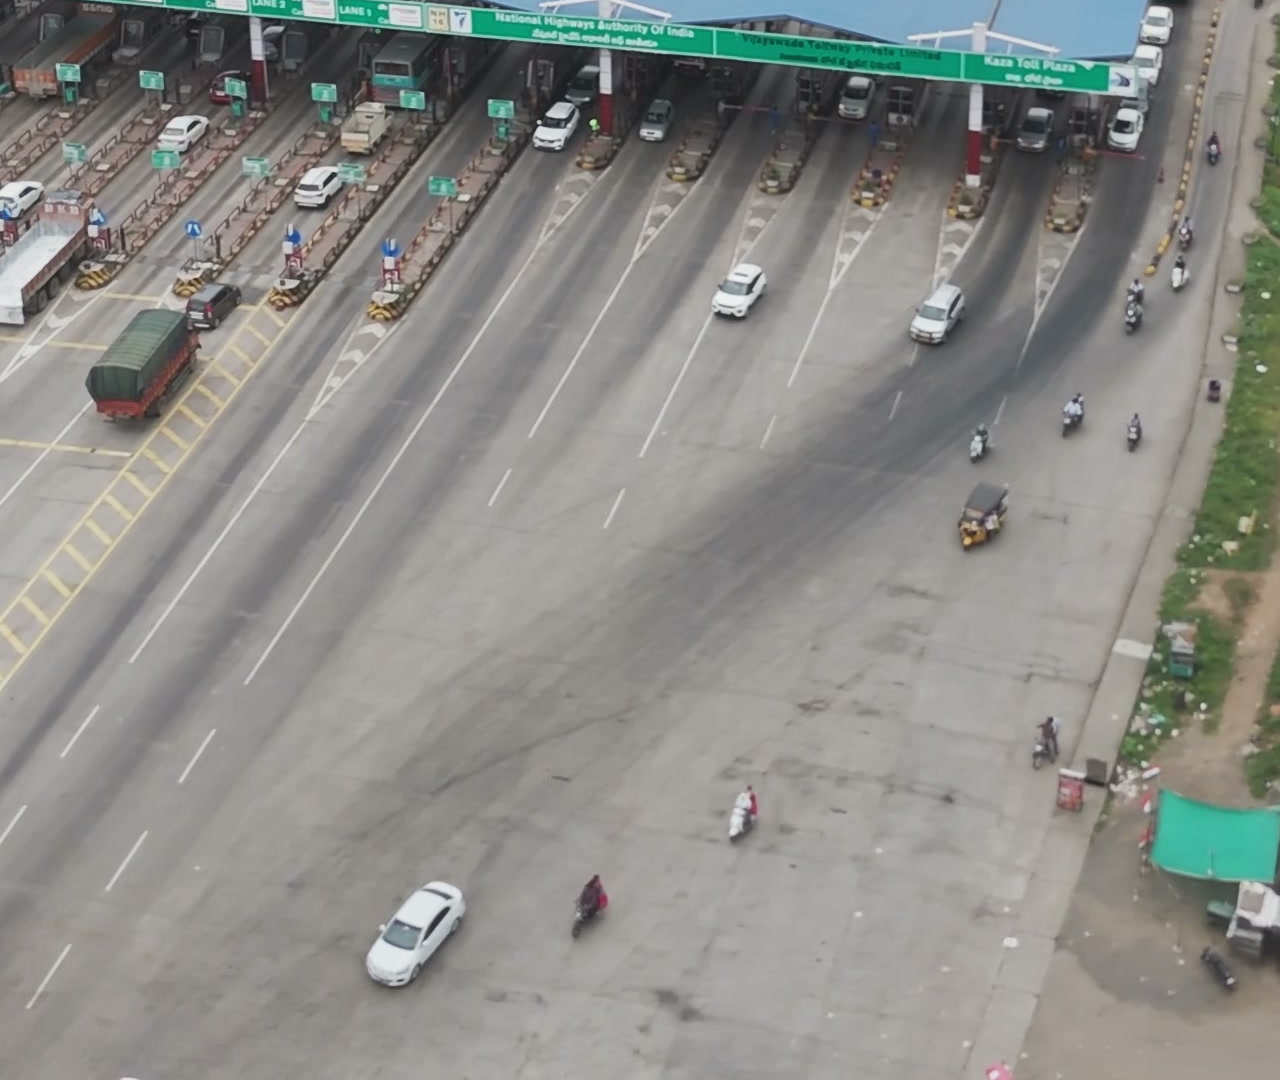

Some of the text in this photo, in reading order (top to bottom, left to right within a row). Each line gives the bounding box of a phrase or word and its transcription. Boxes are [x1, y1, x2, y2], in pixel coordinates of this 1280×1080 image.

[279, 0, 286, 8] 2
[339, 6, 365, 16] LANE
[430, 10, 446, 18] NH
[495, 12, 542, 25] National
[544, 16, 595, 30] Highways
[597, 20, 648, 35] Authority
[651, 24, 665, 34] Of
[668, 27, 695, 38] India
[742, 34, 804, 48] Vijayawada
[808, 40, 851, 54] Tollway
[855, 44, 895, 57] Private
[899, 49, 941, 61] Limited
[984, 56, 1076, 73] Kaza Toll Plaza
